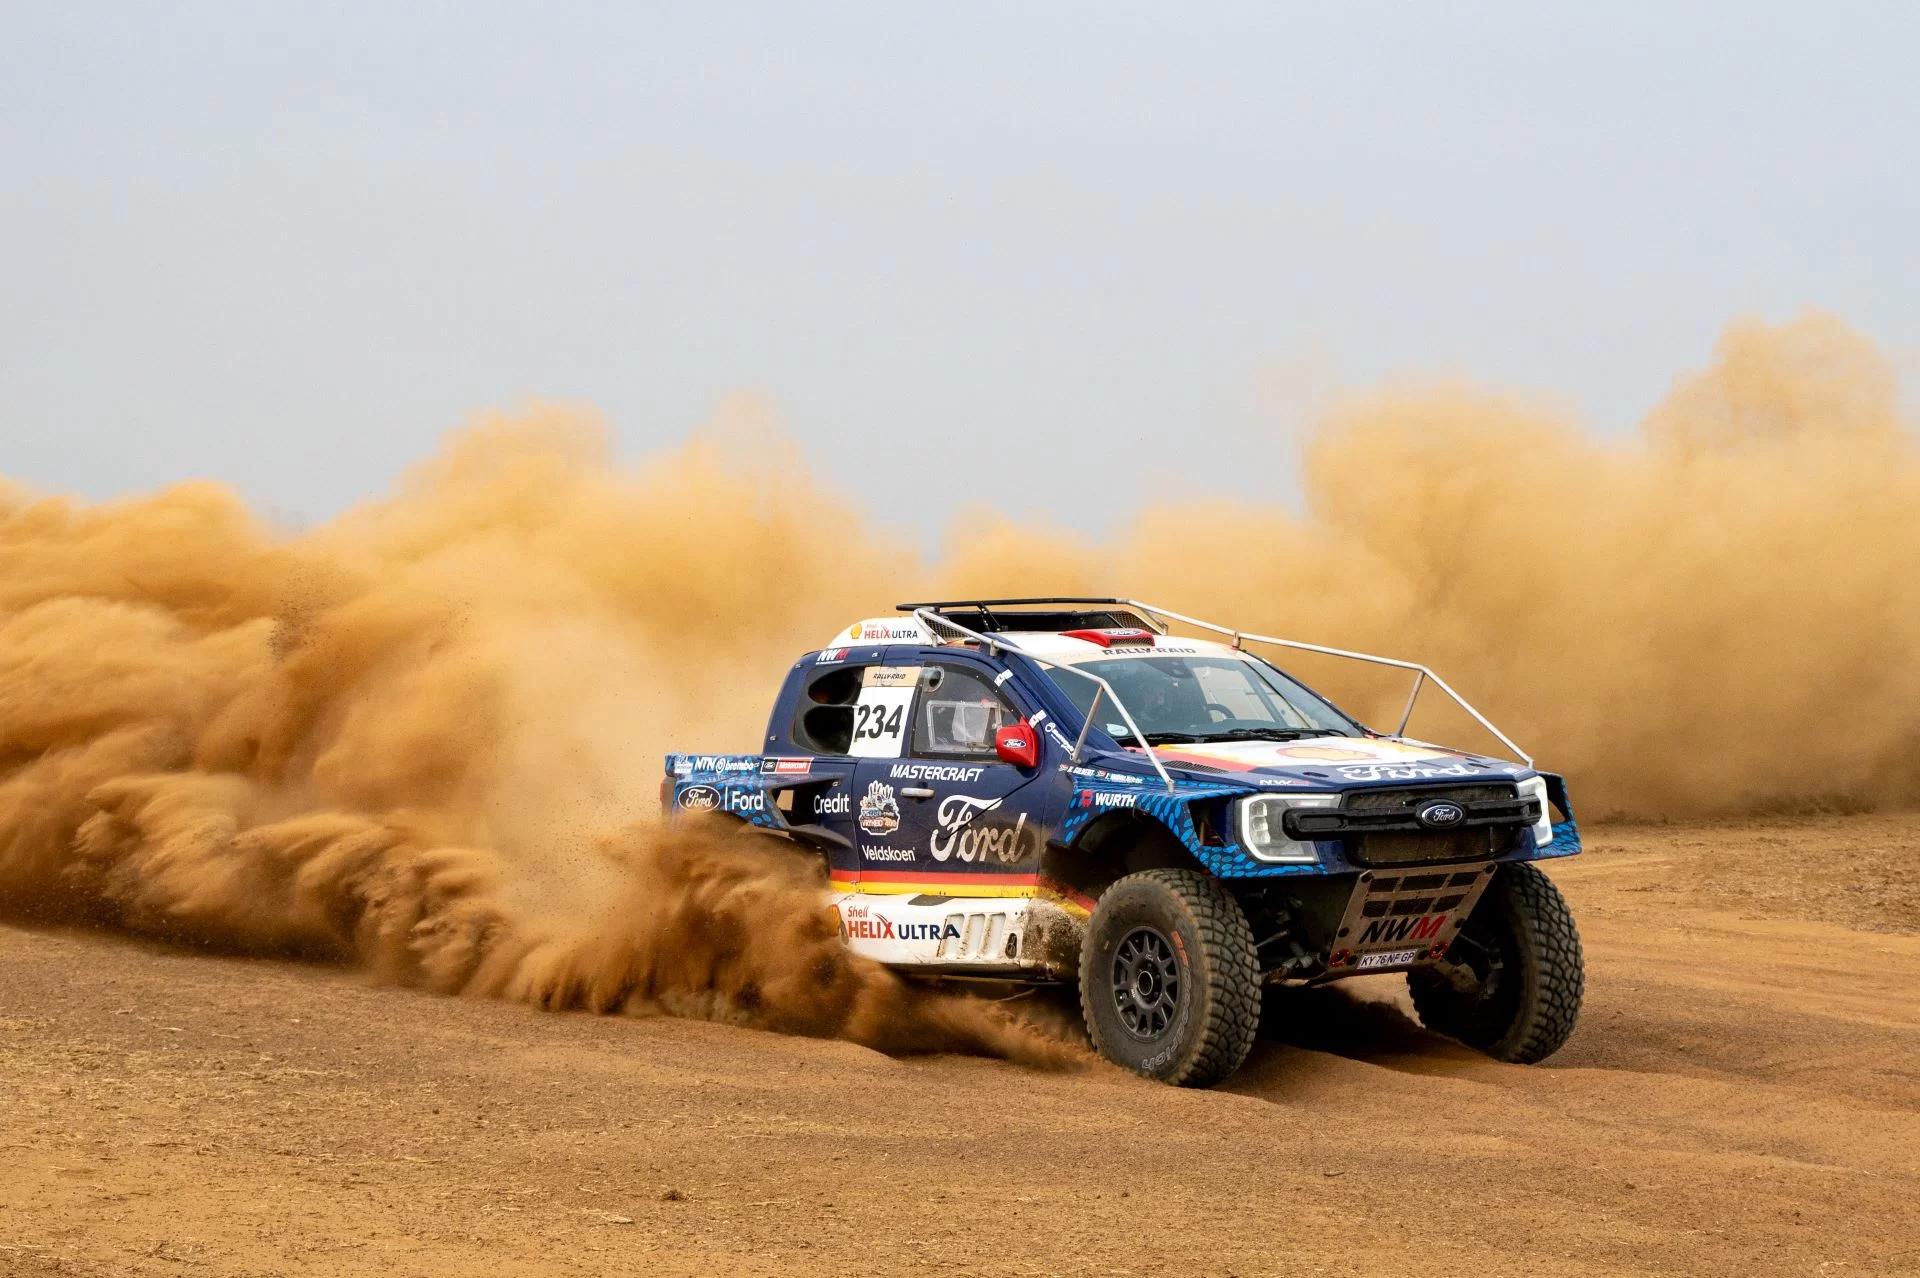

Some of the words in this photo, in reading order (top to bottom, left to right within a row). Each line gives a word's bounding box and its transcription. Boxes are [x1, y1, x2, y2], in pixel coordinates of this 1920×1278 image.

[864, 626, 890, 639] HELIX
[892, 630, 918, 639] ULTRA
[1102, 647, 1197, 656] RALLY-RAID
[854, 704, 904, 742] 234
[694, 757, 716, 771] NTN
[725, 760, 755, 771] brembo
[890, 764, 984, 782] MASTERCRAFT
[1335, 763, 1480, 781] Ford
[685, 788, 713, 808] Ford
[731, 790, 765, 811] Ford
[813, 792, 850, 814] Credit
[1433, 808, 1456, 821] Ford
[930, 794, 1028, 862] Ford
[861, 845, 916, 863] Veldskoen
[847, 905, 870, 918] Shell
[847, 917, 896, 940] HELIX
[898, 923, 961, 941] ULTRA
[1359, 915, 1447, 945] NWM
[1361, 955, 1377, 966] KY
[1401, 951, 1415, 963] GP
